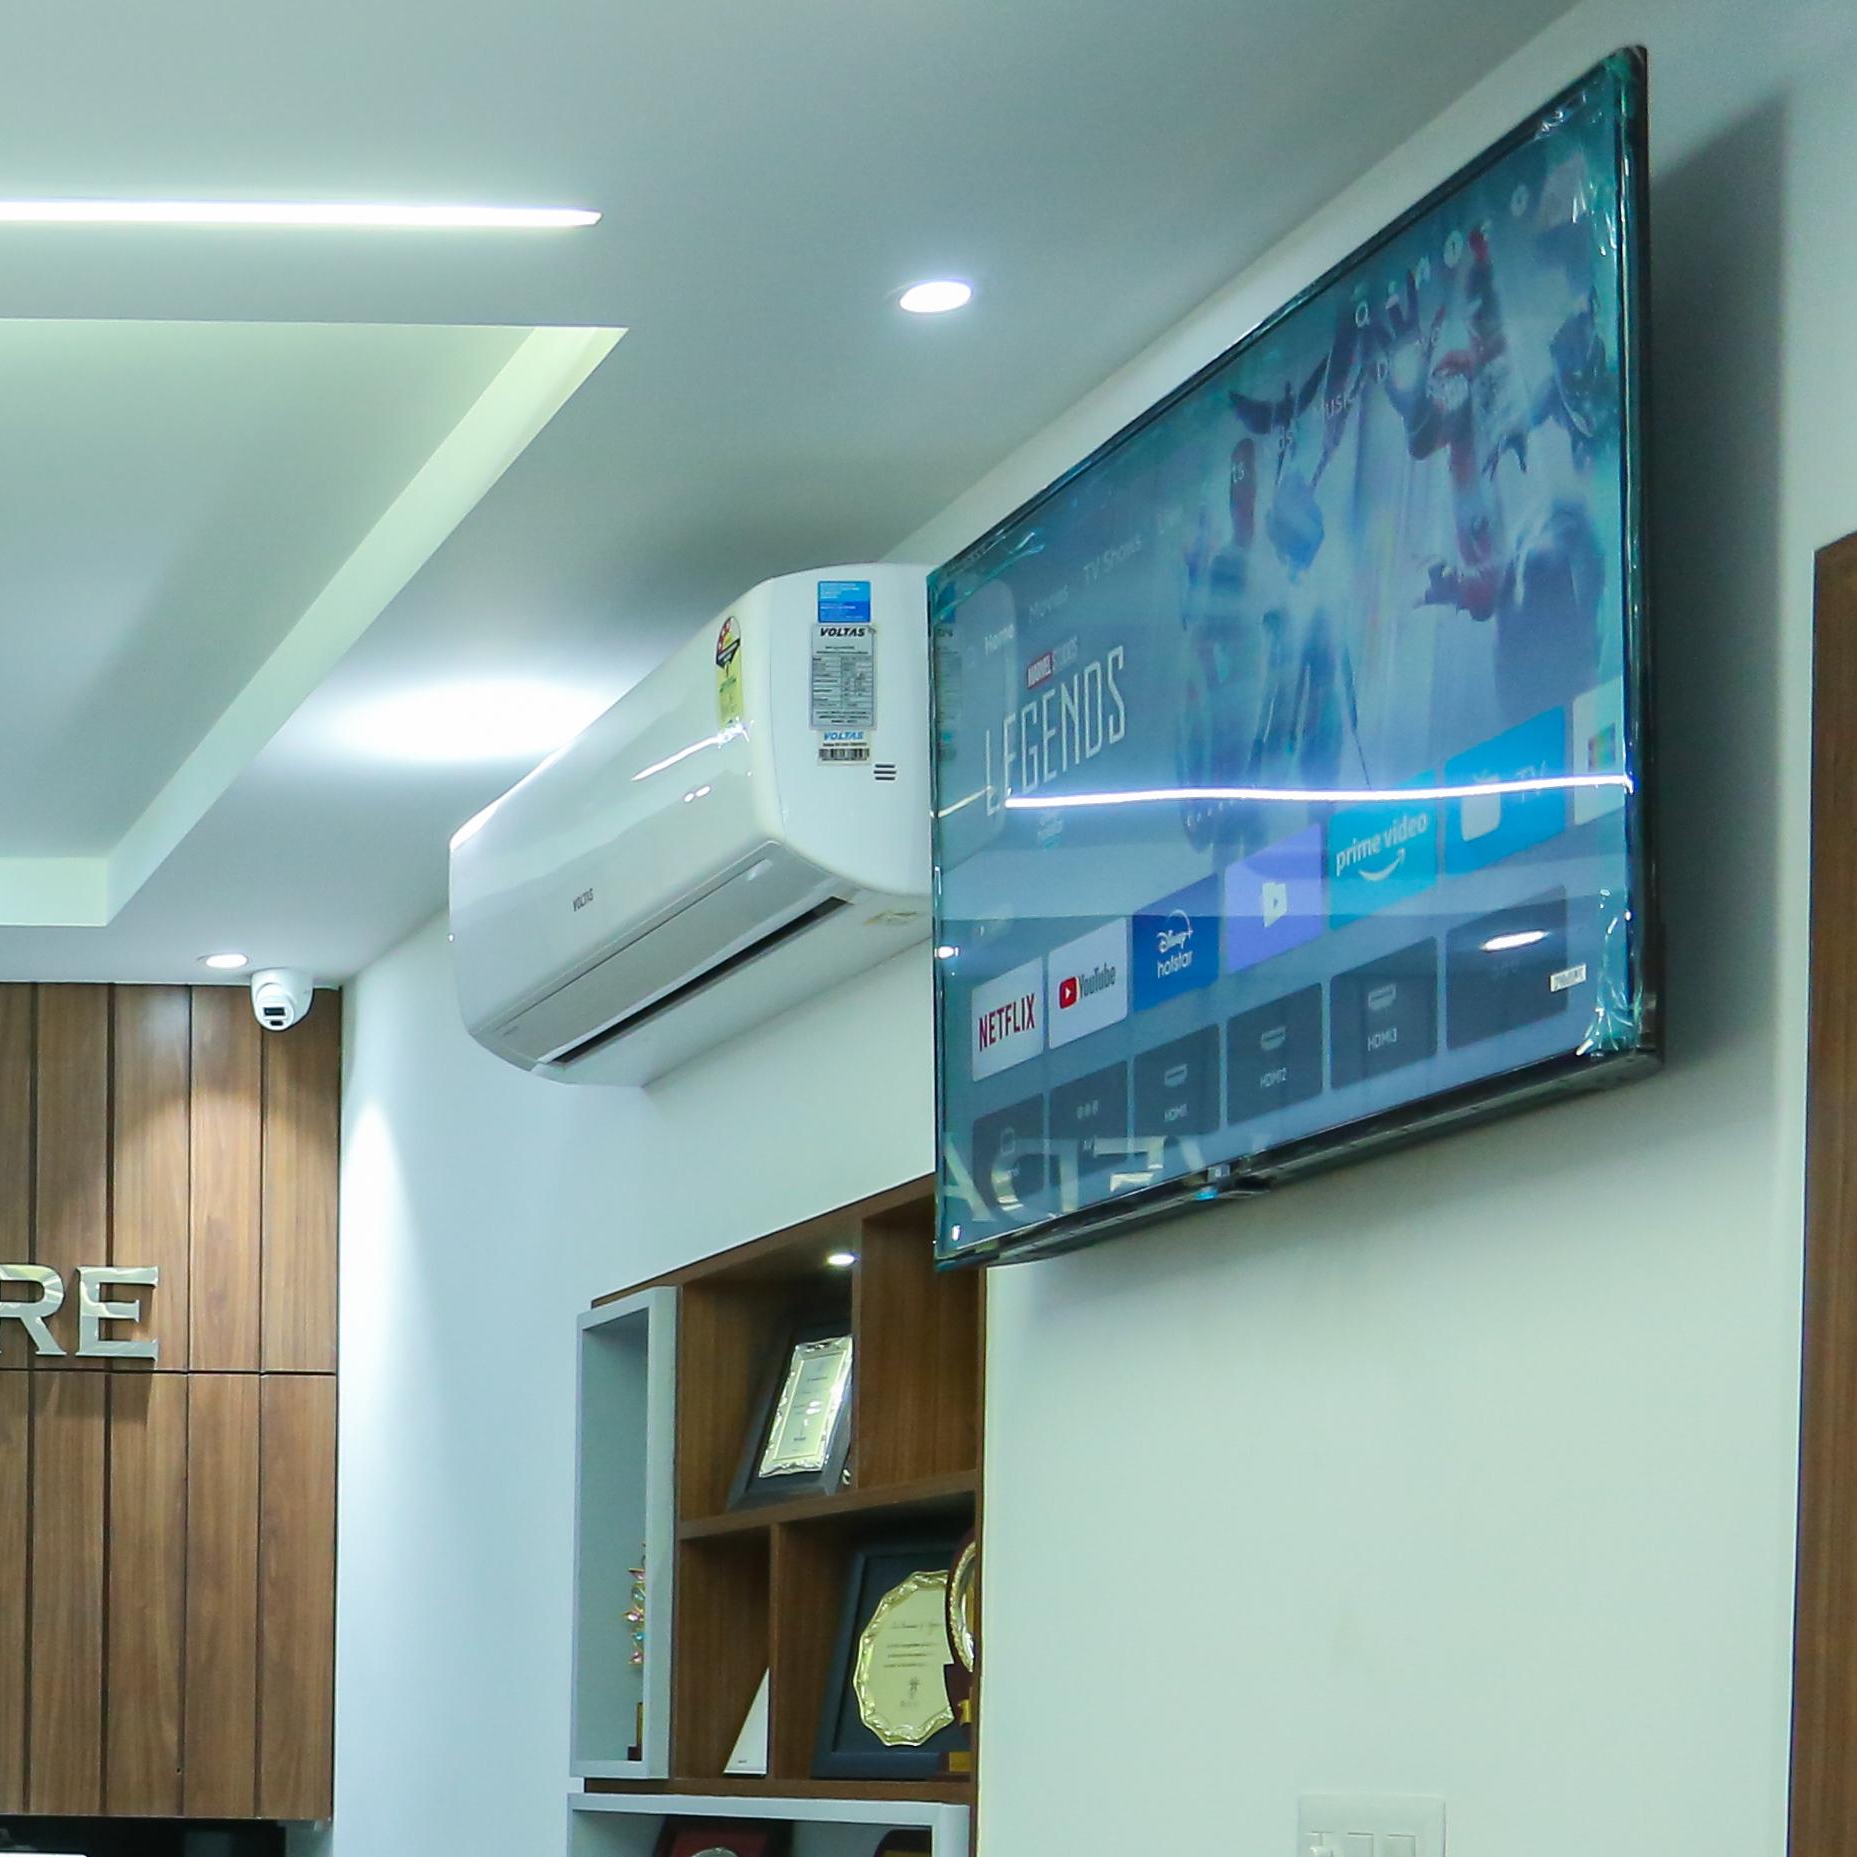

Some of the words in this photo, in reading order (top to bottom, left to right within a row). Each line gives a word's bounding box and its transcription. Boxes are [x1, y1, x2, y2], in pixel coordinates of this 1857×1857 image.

[819, 627, 866, 638] VOLTAS
[823, 731, 865, 742] VOLTAS
[985, 645, 1126, 817] LEGENDS
[1335, 832, 1381, 877] prime
[1383, 812, 1428, 850] video
[1077, 963, 1117, 1000] YouTube
[1156, 950, 1194, 979] hotstar
[979, 993, 1036, 1053] NETFLIX
